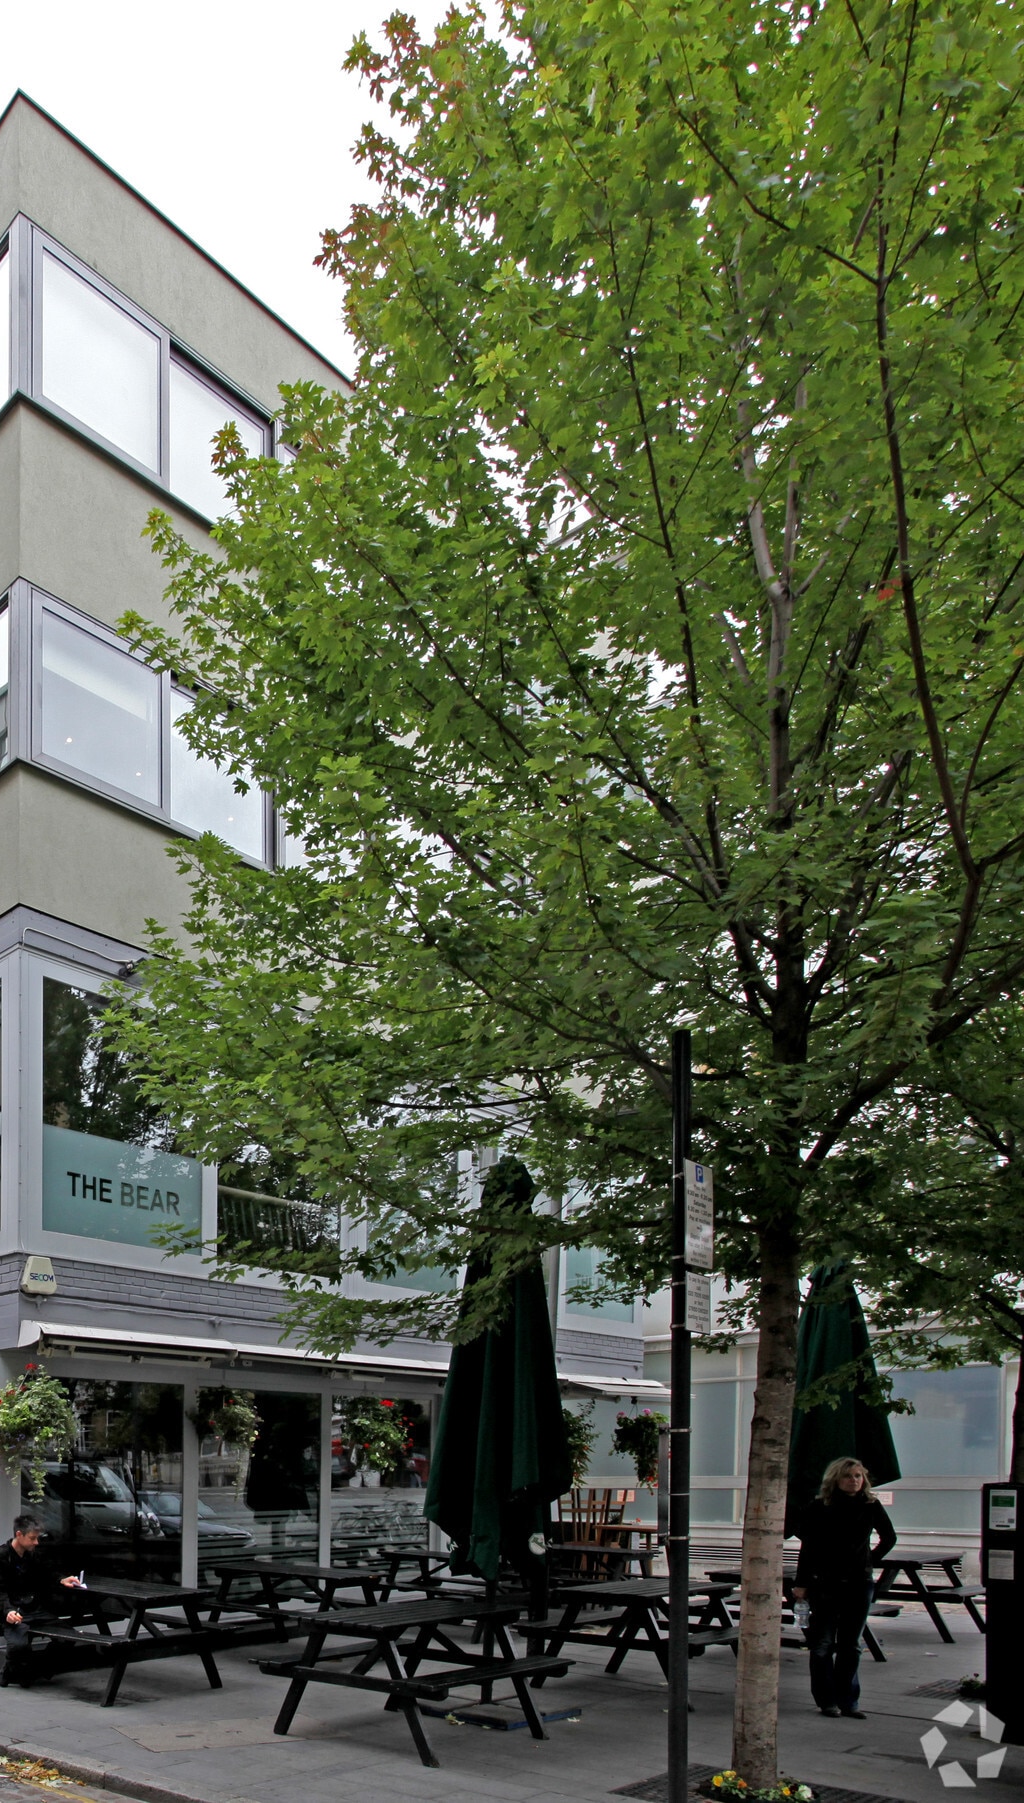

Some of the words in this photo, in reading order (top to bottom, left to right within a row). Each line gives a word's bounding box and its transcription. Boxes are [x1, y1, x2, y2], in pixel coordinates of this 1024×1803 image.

[66, 1171, 112, 1203] THE
[120, 1182, 180, 1216] BEAR
[30, 1272, 54, 1282] SECOM
